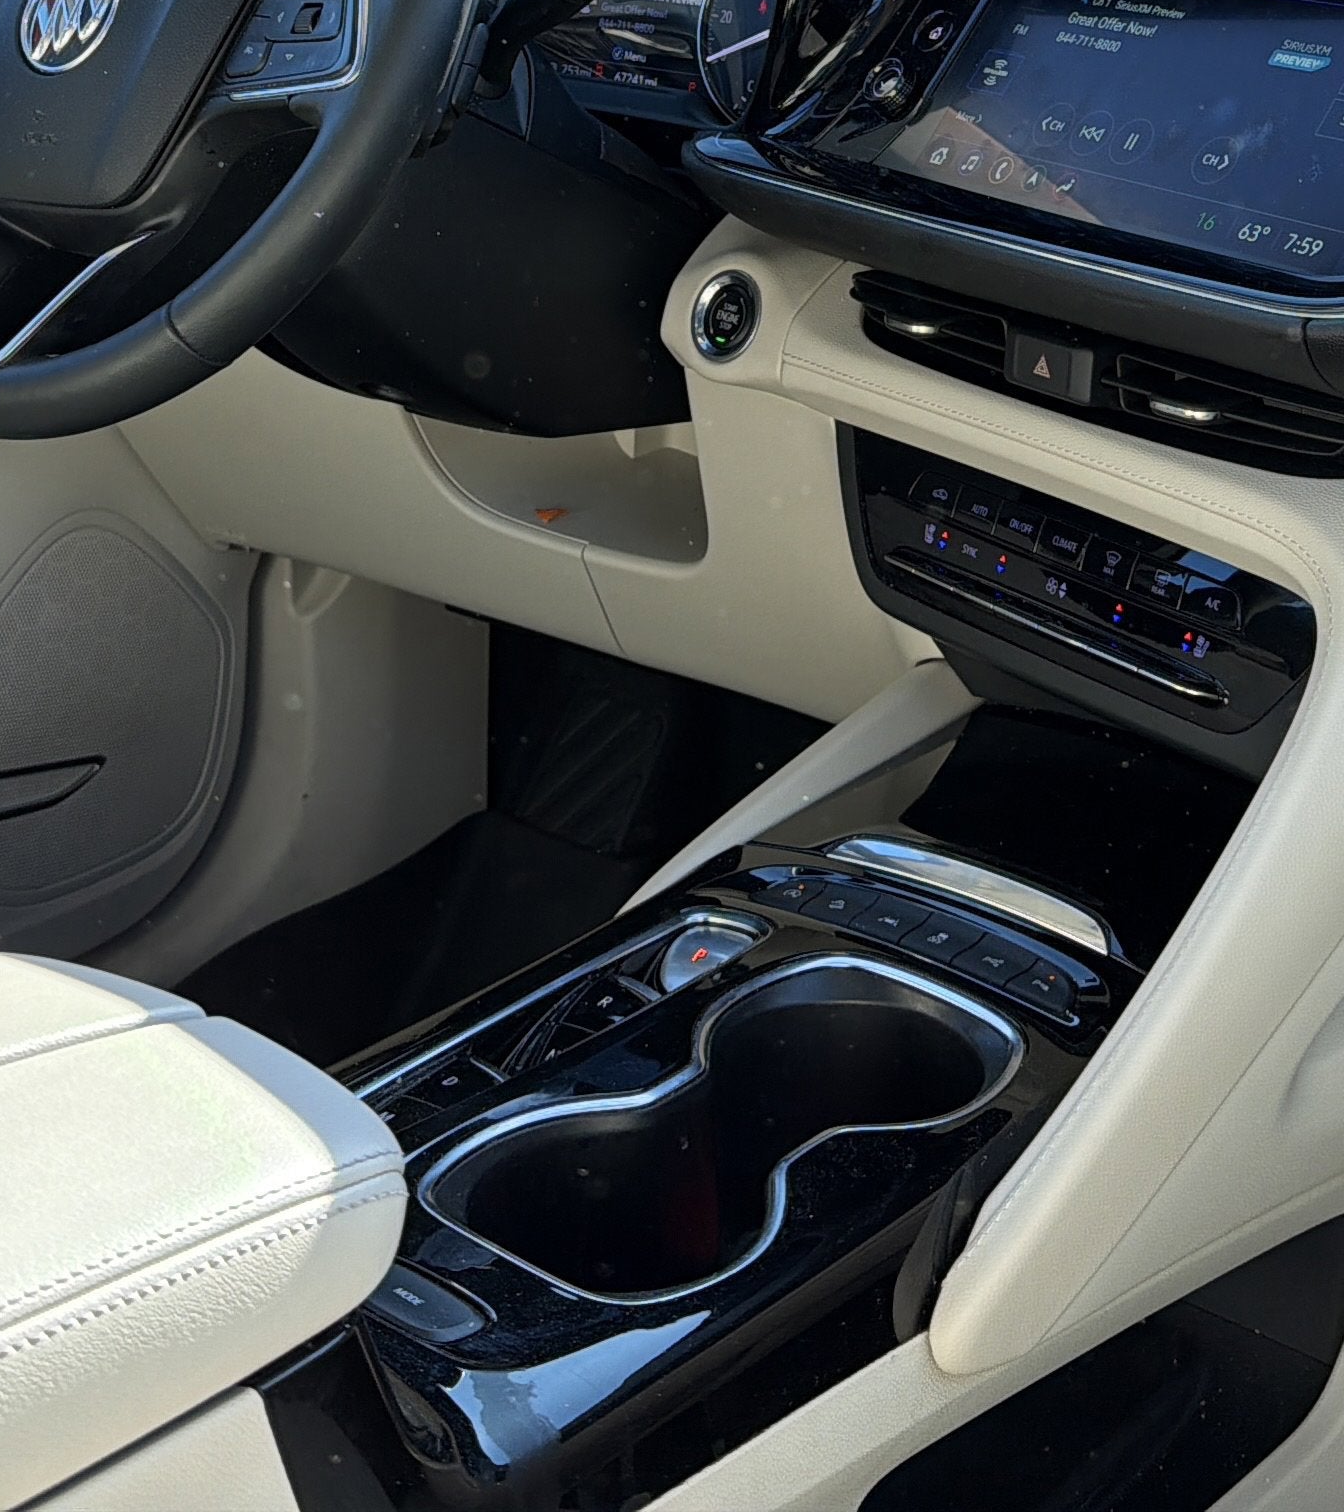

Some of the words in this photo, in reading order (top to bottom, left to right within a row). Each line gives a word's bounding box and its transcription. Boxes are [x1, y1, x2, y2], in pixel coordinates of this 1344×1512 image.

[719, 9, 733, 25] 20
[1115, 0, 1153, 14] SiriusXM
[1152, 5, 1186, 20] Preview
[1012, 23, 1031, 36] FM
[1067, 11, 1098, 29] Great
[1098, 16, 1126, 33] Offer
[1125, 20, 1159, 38] Now!
[1056, 31, 1122, 53] 844-711-8800
[1280, 39, 1333, 56] SIRIUSXM
[624, 50, 647, 63] Menu
[1049, 119, 1066, 132] CH
[1202, 153, 1220, 167] CH
[1196, 211, 1217, 231] 16
[1238, 223, 1272, 242] 63°
[1283, 232, 1324, 257] 7:59
[715, 309, 741, 326] ENGINE
[970, 503, 989, 518] AUTO
[1008, 518, 1034, 535] ON/OFF
[960, 543, 979, 559] SYNC
[1052, 535, 1079, 554] CLIMATE
[1205, 595, 1221, 611] A/C
[691, 947, 707, 963] P
[596, 995, 613, 1009] R
[392, 1287, 426, 1306] MODE
